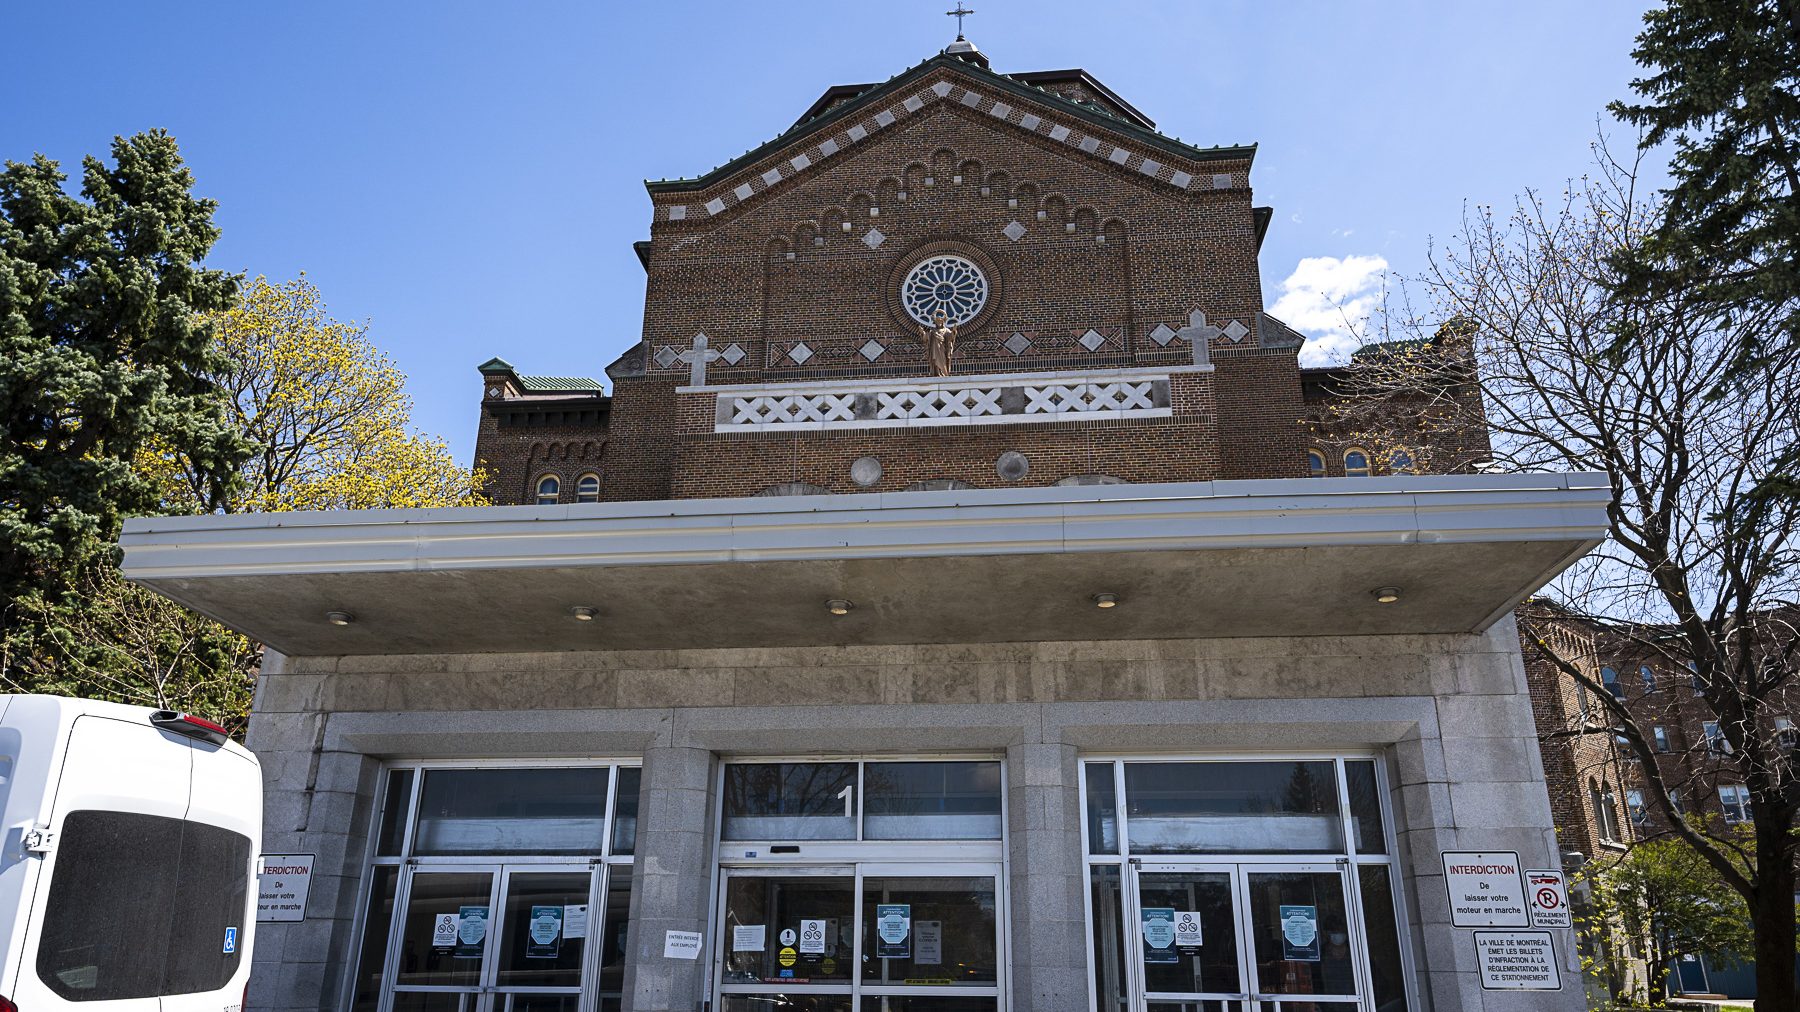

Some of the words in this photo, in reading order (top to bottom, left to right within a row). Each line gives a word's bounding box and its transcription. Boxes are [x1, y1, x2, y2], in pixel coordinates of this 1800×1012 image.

[837, 785, 853, 818] 1
[263, 866, 308, 874] TERDICTION
[1449, 865, 1515, 875] INTERDICTION
[1480, 882, 1489, 890] De
[1464, 894, 1488, 902] laisser
[1456, 906, 1481, 914] moteur
[1495, 906, 1522, 914] marche
[1516, 938, 1549, 946] MONTRÉAL
[1487, 947, 1504, 955] ÉMET
[1530, 955, 1536, 963] À
